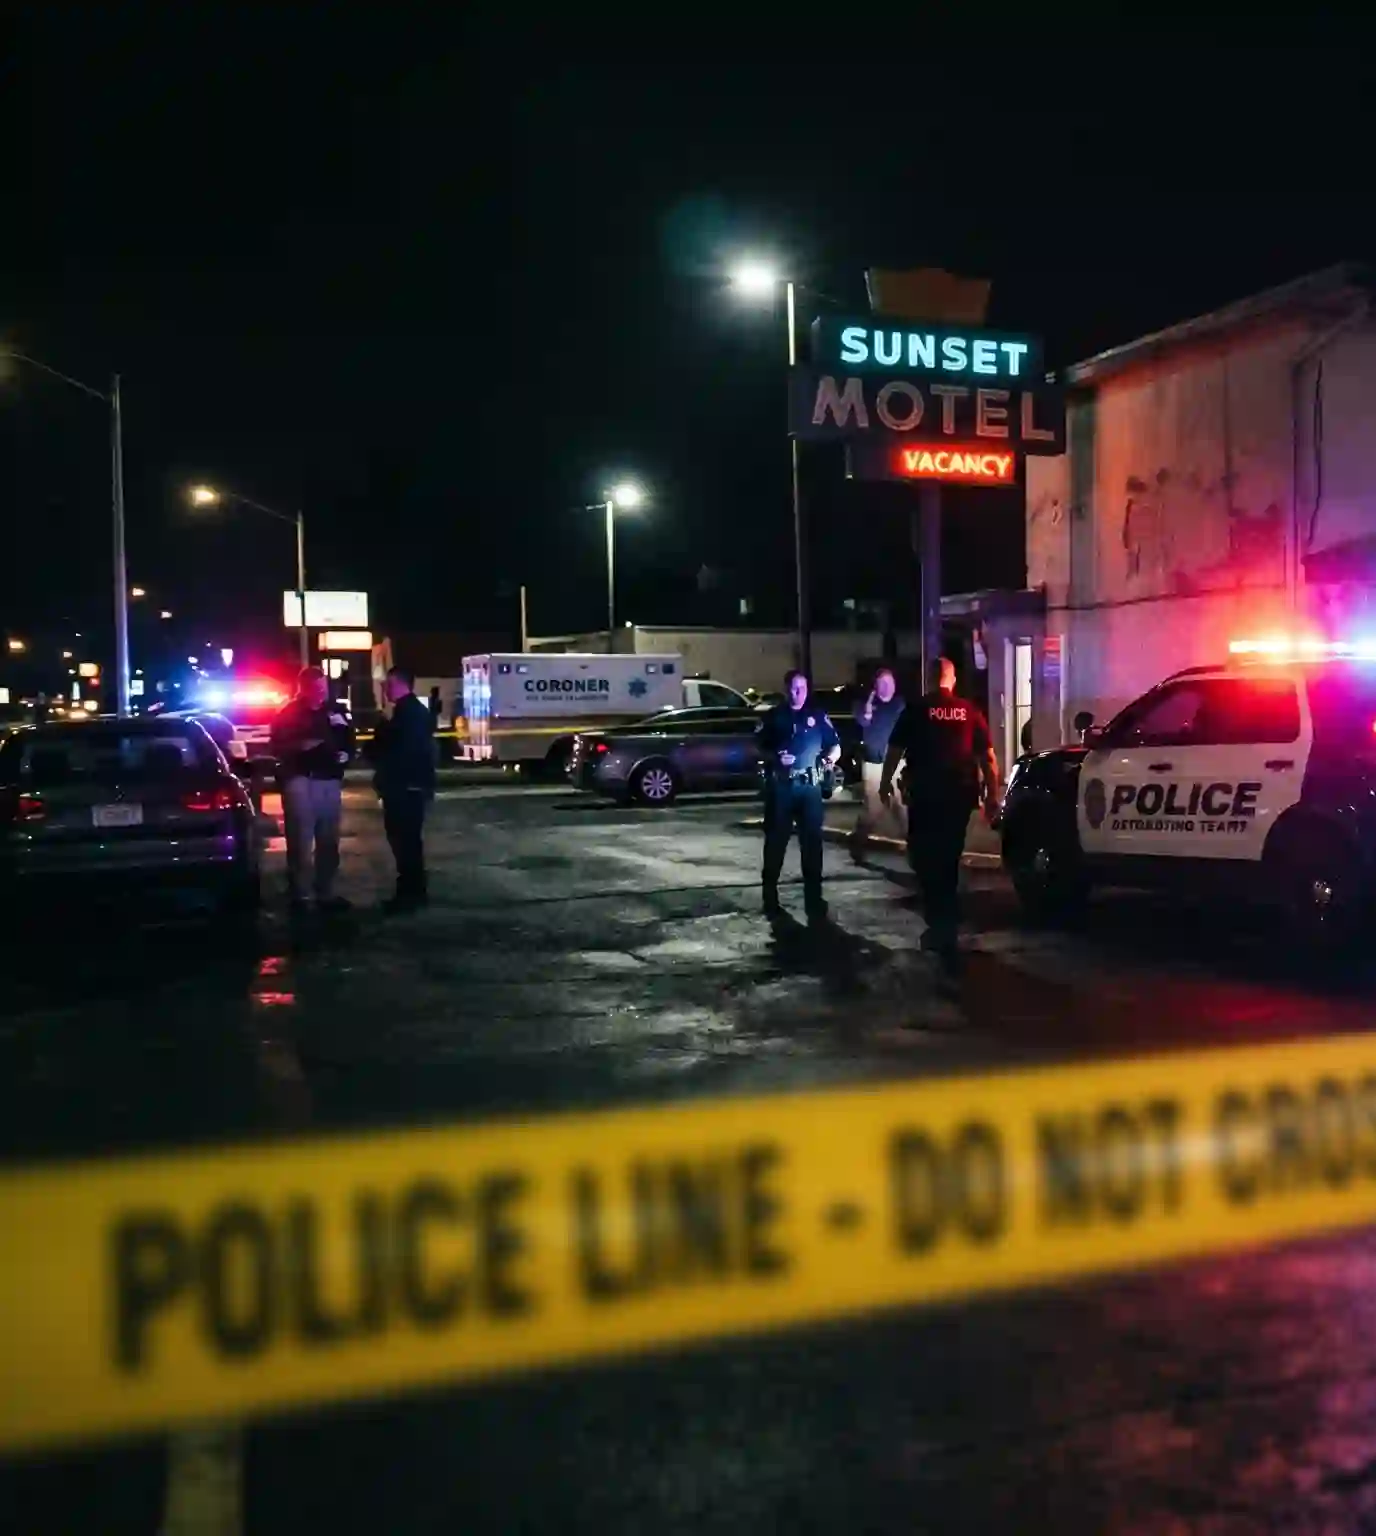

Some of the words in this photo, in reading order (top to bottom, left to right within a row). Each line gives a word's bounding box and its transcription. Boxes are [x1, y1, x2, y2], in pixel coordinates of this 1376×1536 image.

[840, 326, 1027, 376] SUNSET
[811, 375, 1055, 441] MOTEL
[903, 450, 1012, 477] VACANCY
[524, 679, 610, 692] CORONER
[929, 706, 967, 721] POLICE
[1110, 781, 1262, 817] POLICE
[108, 1167, 534, 1376] POLICE
[572, 1140, 788, 1304] LINE
[889, 1120, 1009, 1260] DO
[1034, 1096, 1182, 1230] NOT
